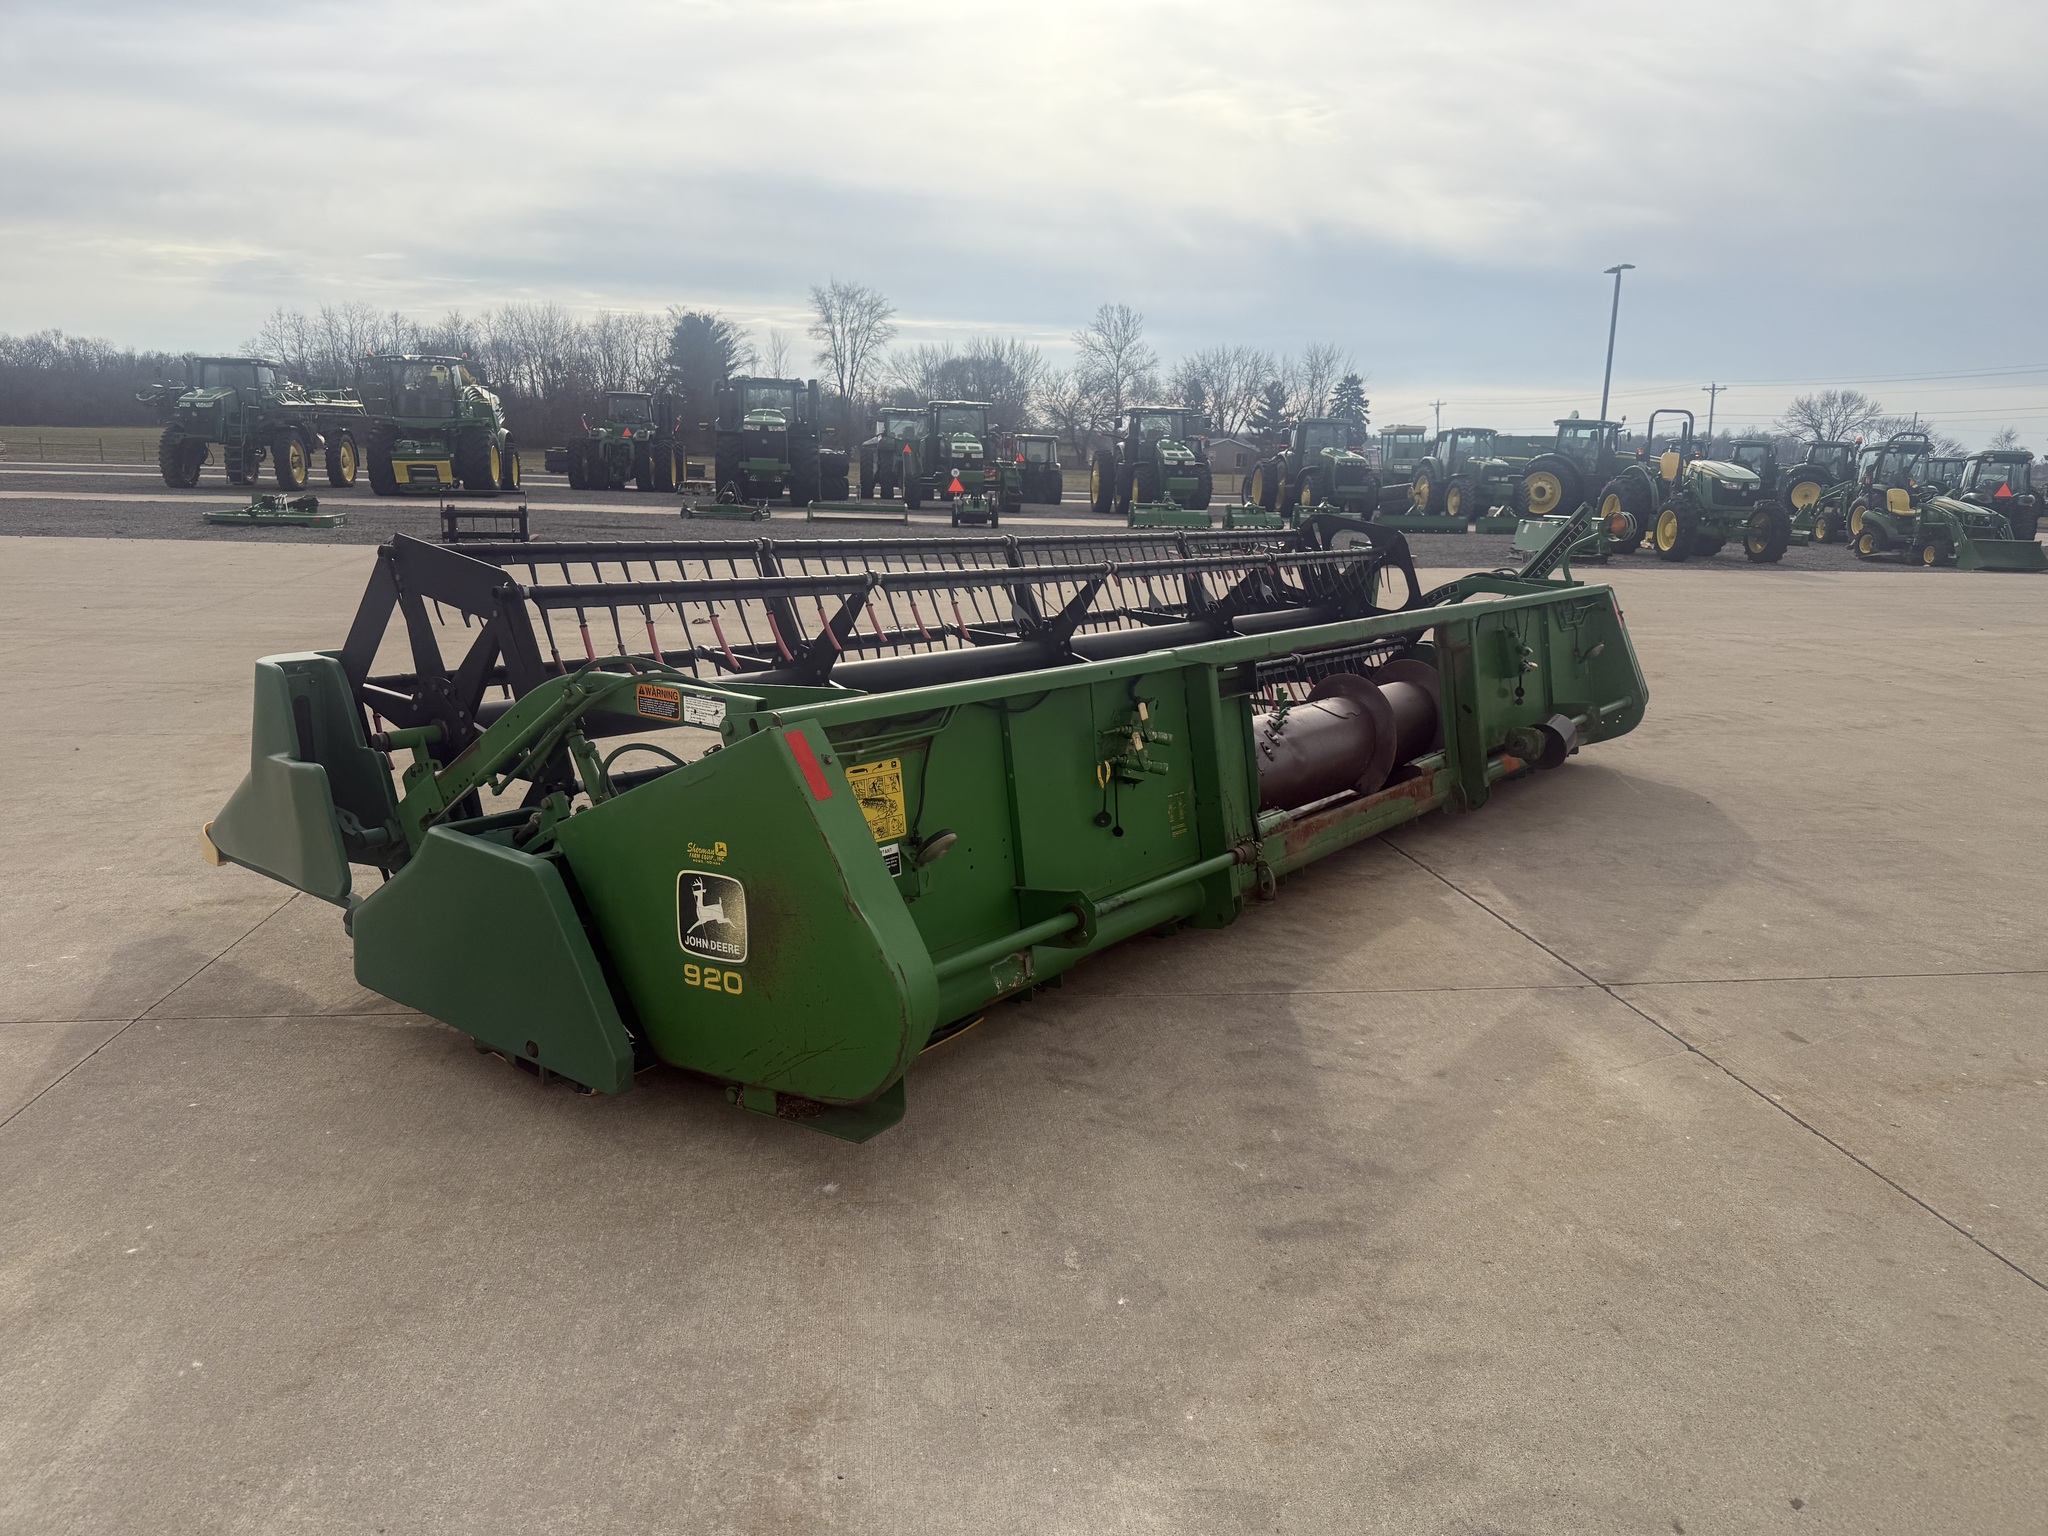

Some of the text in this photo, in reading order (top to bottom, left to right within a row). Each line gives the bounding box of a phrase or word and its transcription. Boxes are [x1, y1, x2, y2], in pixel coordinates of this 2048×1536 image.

[644, 686, 679, 700] WARNING
[687, 842, 715, 856] Sherman
[685, 935, 740, 955] JOHN DEERE
[684, 963, 743, 995] 920
